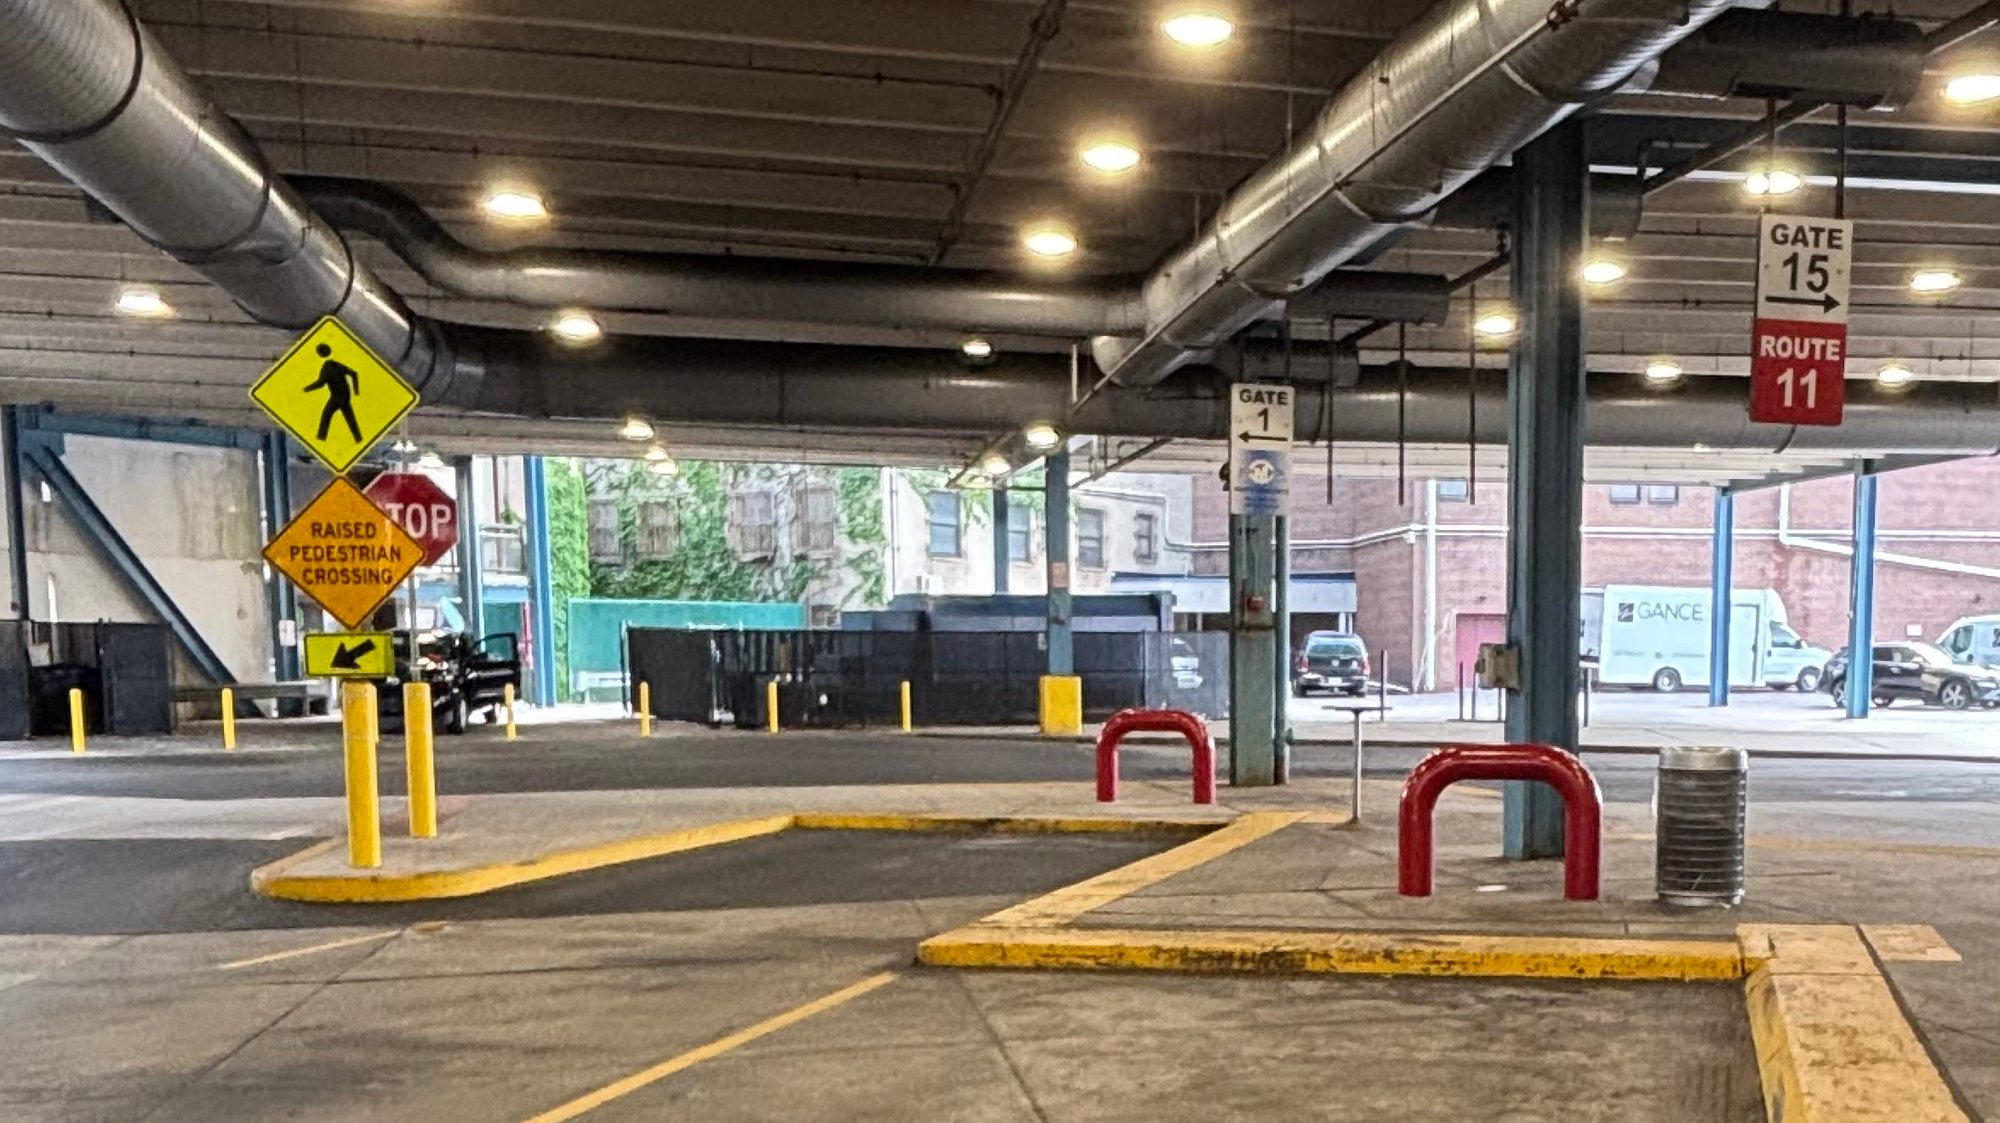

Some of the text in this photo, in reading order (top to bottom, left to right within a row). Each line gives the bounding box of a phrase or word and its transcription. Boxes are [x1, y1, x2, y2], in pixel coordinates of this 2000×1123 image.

[1770, 223, 1844, 250] GATE
[1782, 252, 1829, 292] 15
[1760, 335, 1841, 361] ROUTE
[1239, 389, 1288, 405] GATE
[1777, 367, 1817, 409] 11
[1257, 407, 1269, 432] 1
[311, 522, 377, 539] RAISED
[382, 502, 452, 539] TOP
[289, 546, 400, 562] PEDESTRIAN
[302, 569, 393, 585] CROSSING
[1637, 602, 1703, 621] GANCE
